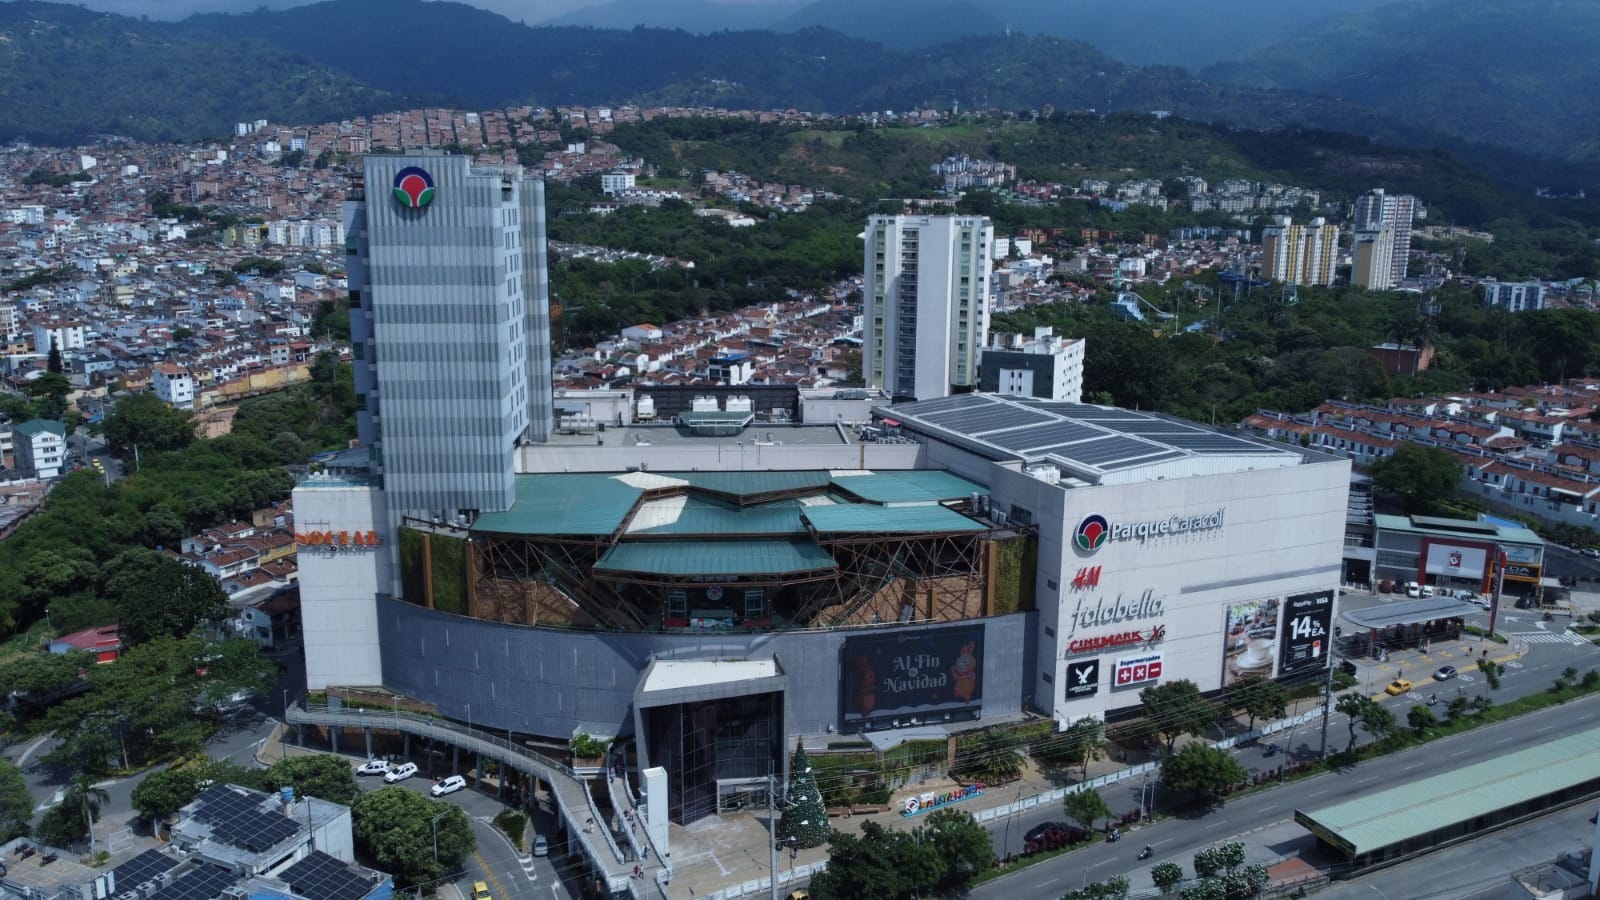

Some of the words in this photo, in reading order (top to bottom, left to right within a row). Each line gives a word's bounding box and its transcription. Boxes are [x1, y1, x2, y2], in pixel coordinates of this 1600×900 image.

[295, 530, 383, 546] SOCIAL
[1073, 565, 1102, 590] H&M
[1290, 615, 1312, 640] 14
[1070, 631, 1144, 652] CINEMARK
[893, 656, 911, 672] Al
[914, 653, 940, 669] Fin
[1119, 655, 1161, 667] Supermercados
[883, 672, 947, 693] Navidad
